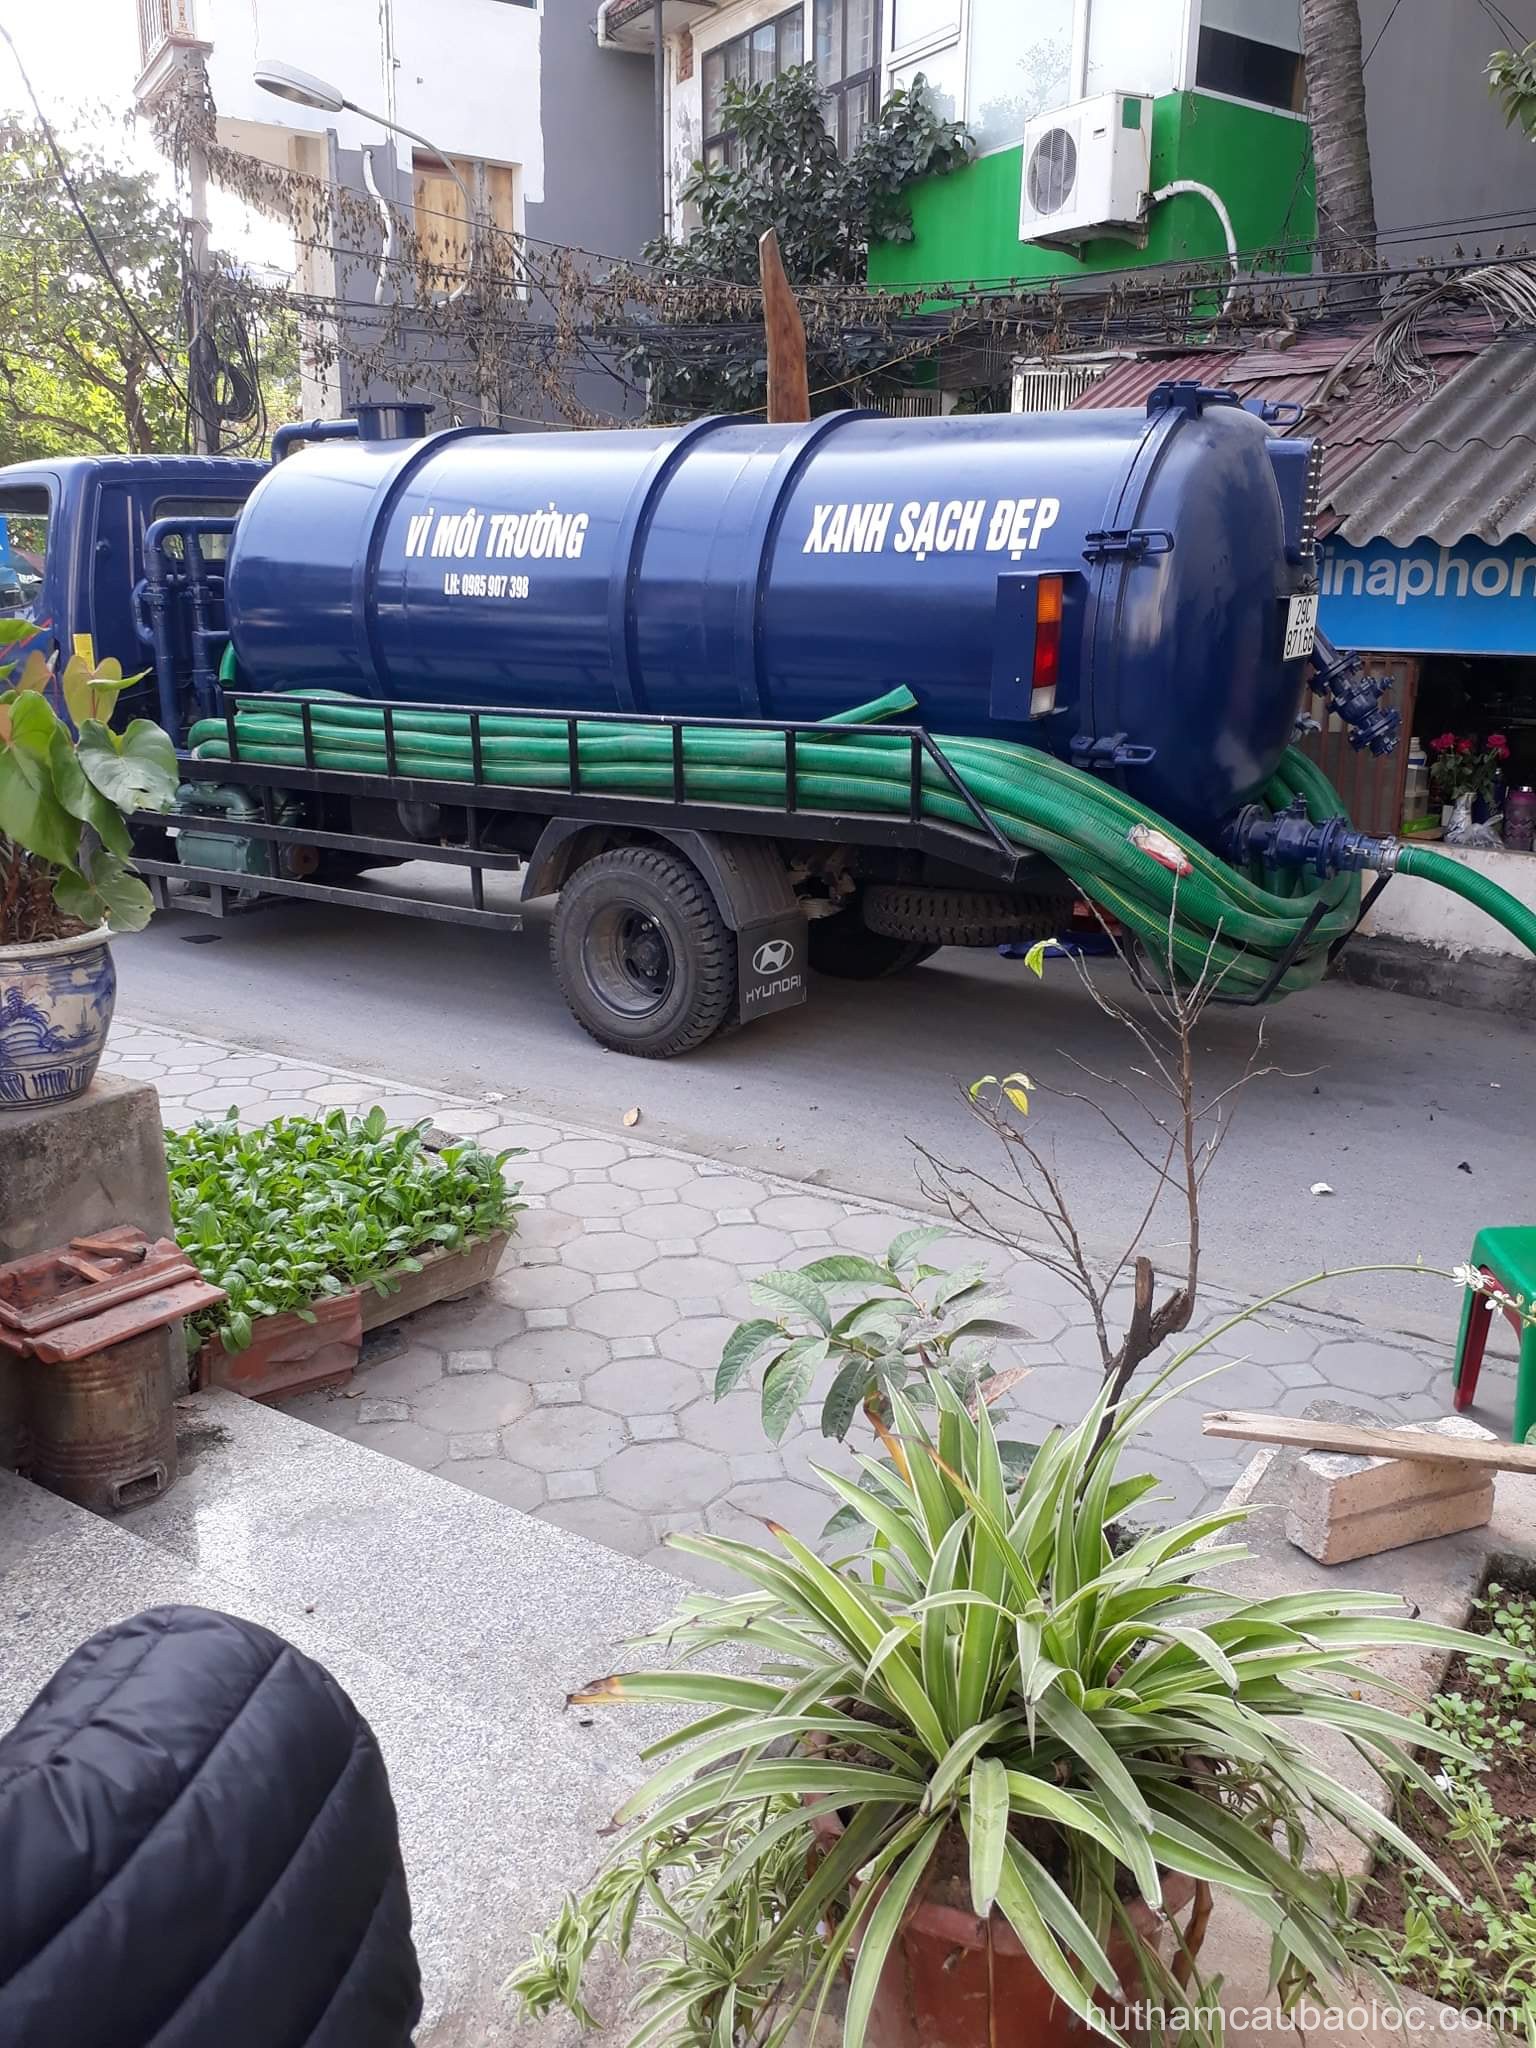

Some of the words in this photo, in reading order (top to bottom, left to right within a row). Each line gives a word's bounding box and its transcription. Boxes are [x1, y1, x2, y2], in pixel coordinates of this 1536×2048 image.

[431, 507, 485, 558] MÔI
[485, 501, 589, 559] TRƯỜNG
[802, 502, 894, 553] XANH
[893, 500, 986, 561] SẠCH
[985, 498, 1060, 561] ĐẸP
[444, 573, 460, 595] LH:
[461, 574, 487, 597] 0985
[487, 574, 508, 598] 907
[508, 575, 529, 599] 398
[1296, 598, 1313, 626] 29C
[745, 974, 802, 1004] HYUNDAI
